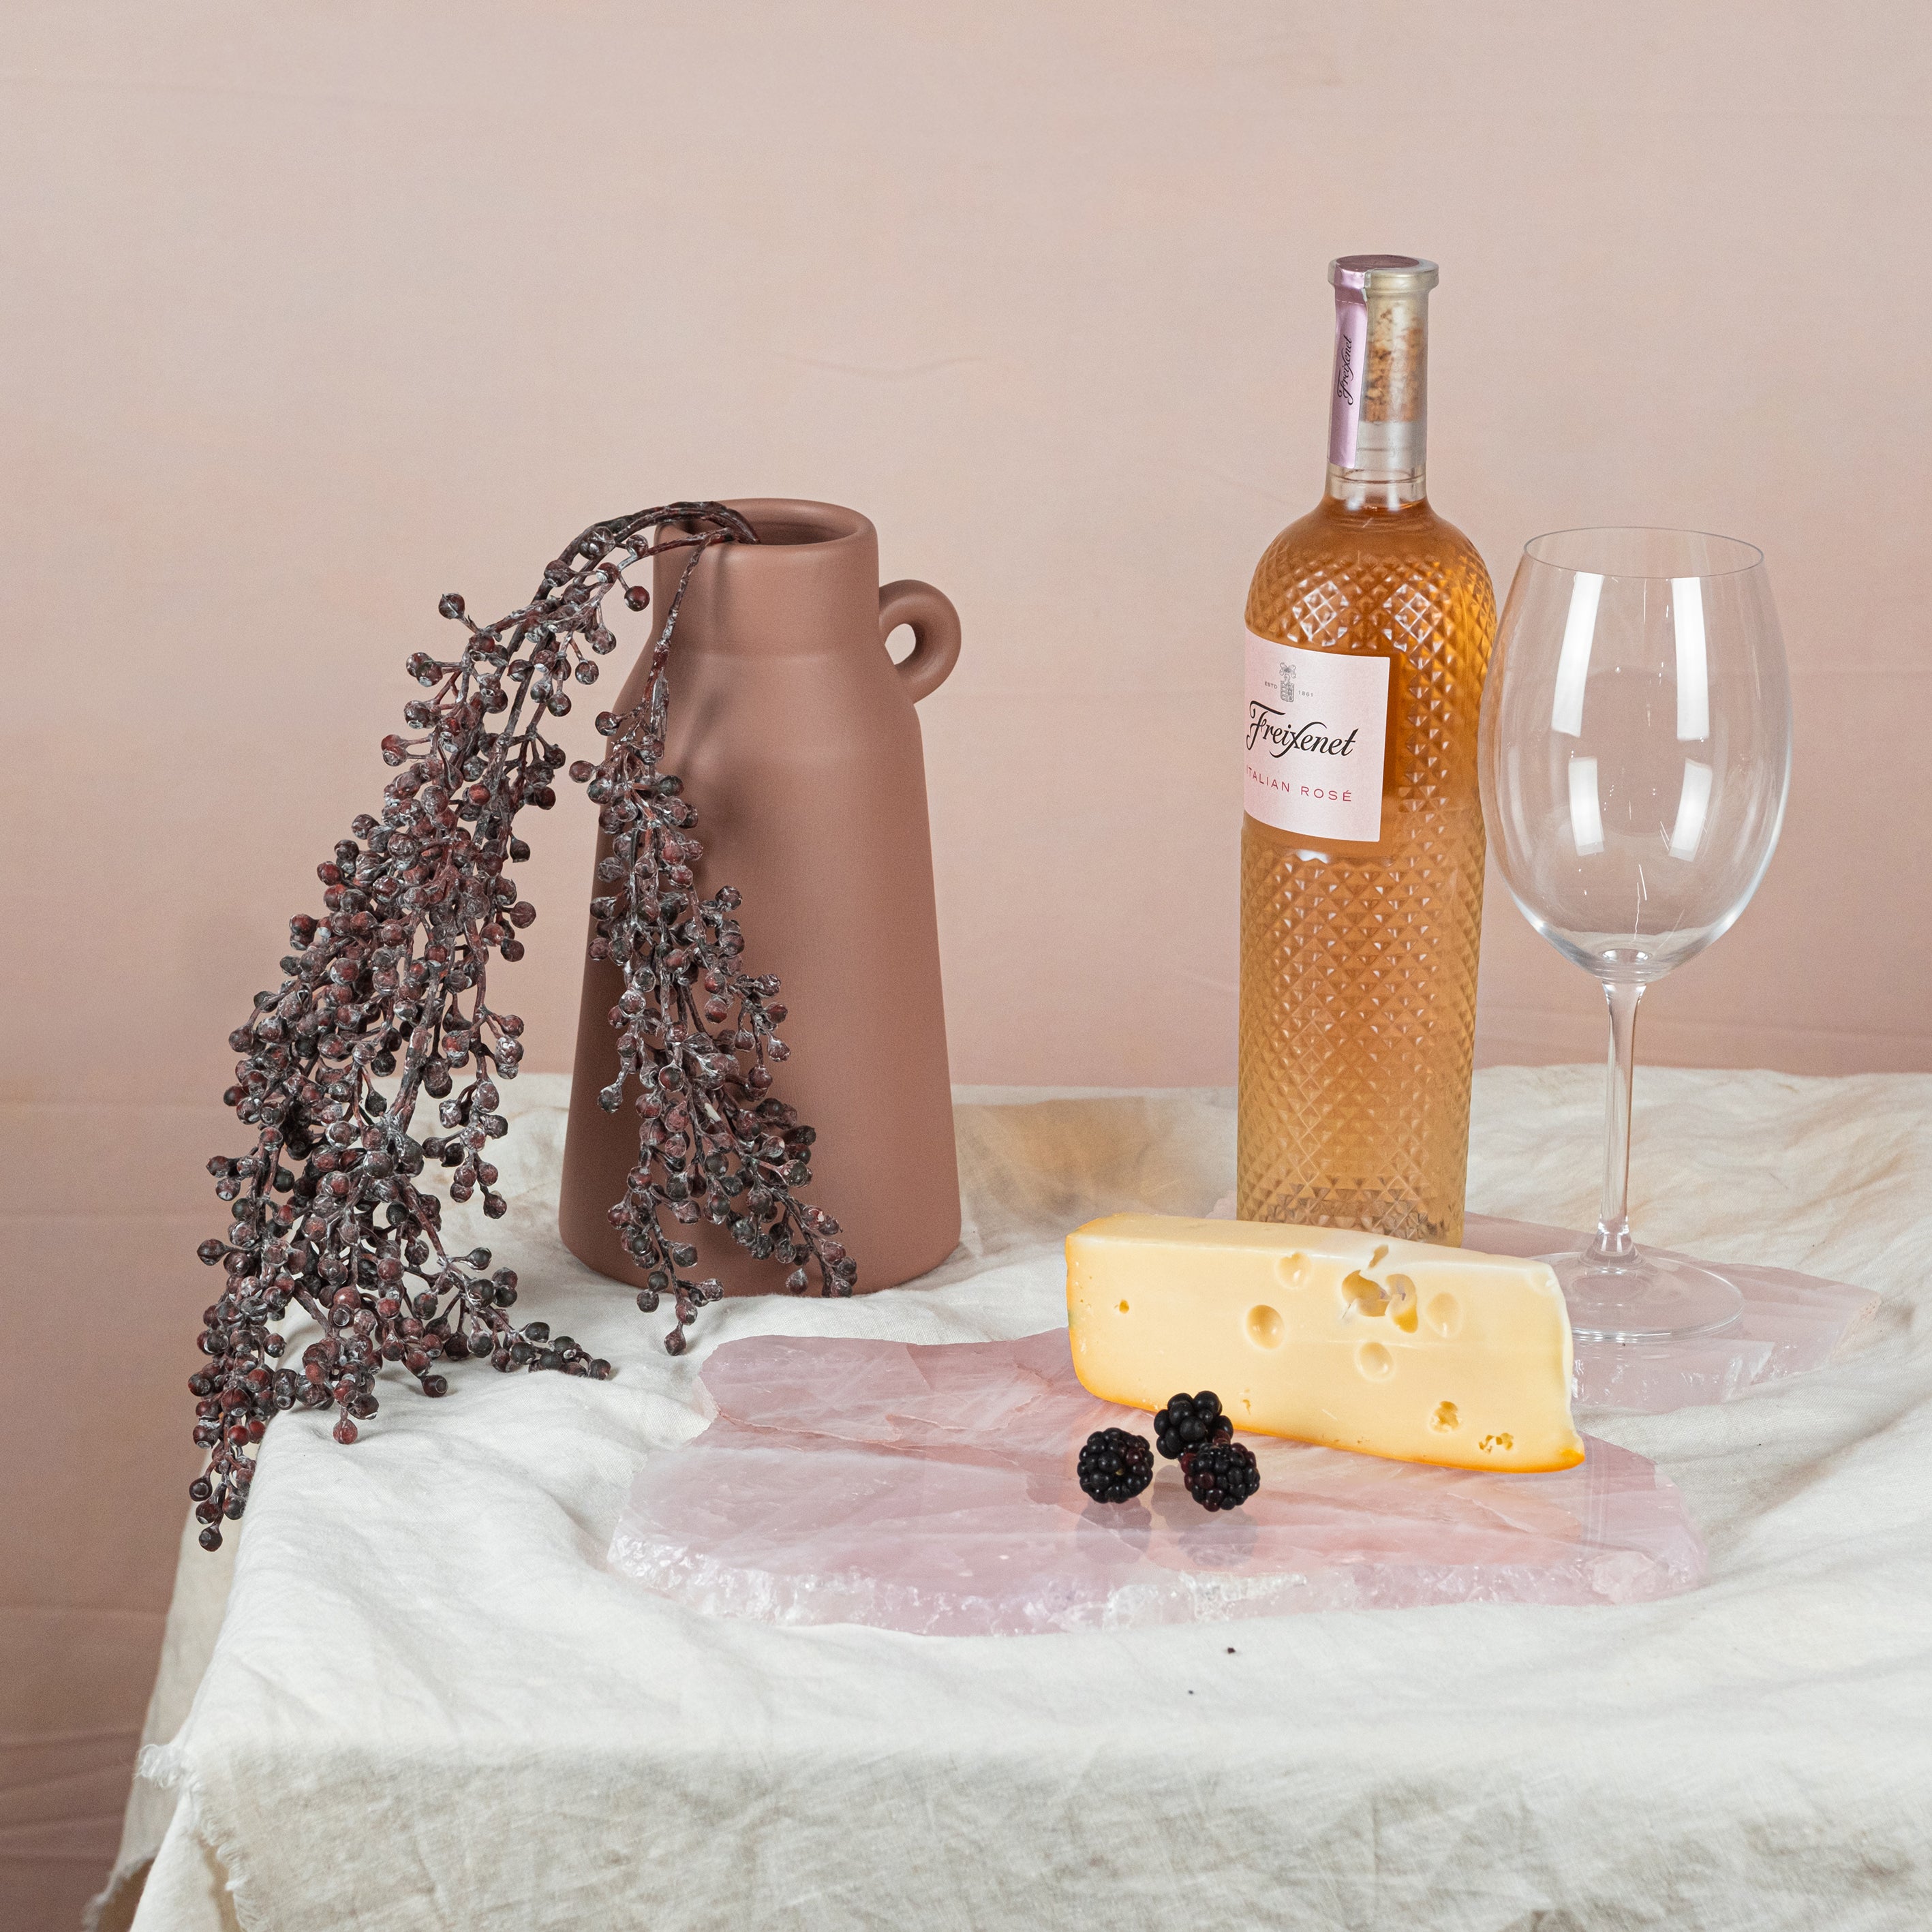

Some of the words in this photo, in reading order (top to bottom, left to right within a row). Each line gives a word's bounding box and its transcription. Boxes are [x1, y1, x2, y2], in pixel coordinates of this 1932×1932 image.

[1336, 334, 1354, 405] Freixenet
[1264, 681, 1278, 690] ESTD
[1246, 700, 1360, 758] Freixenet
[1246, 765, 1290, 793] ITALIAN
[1300, 785, 1352, 802] ROSÉ
